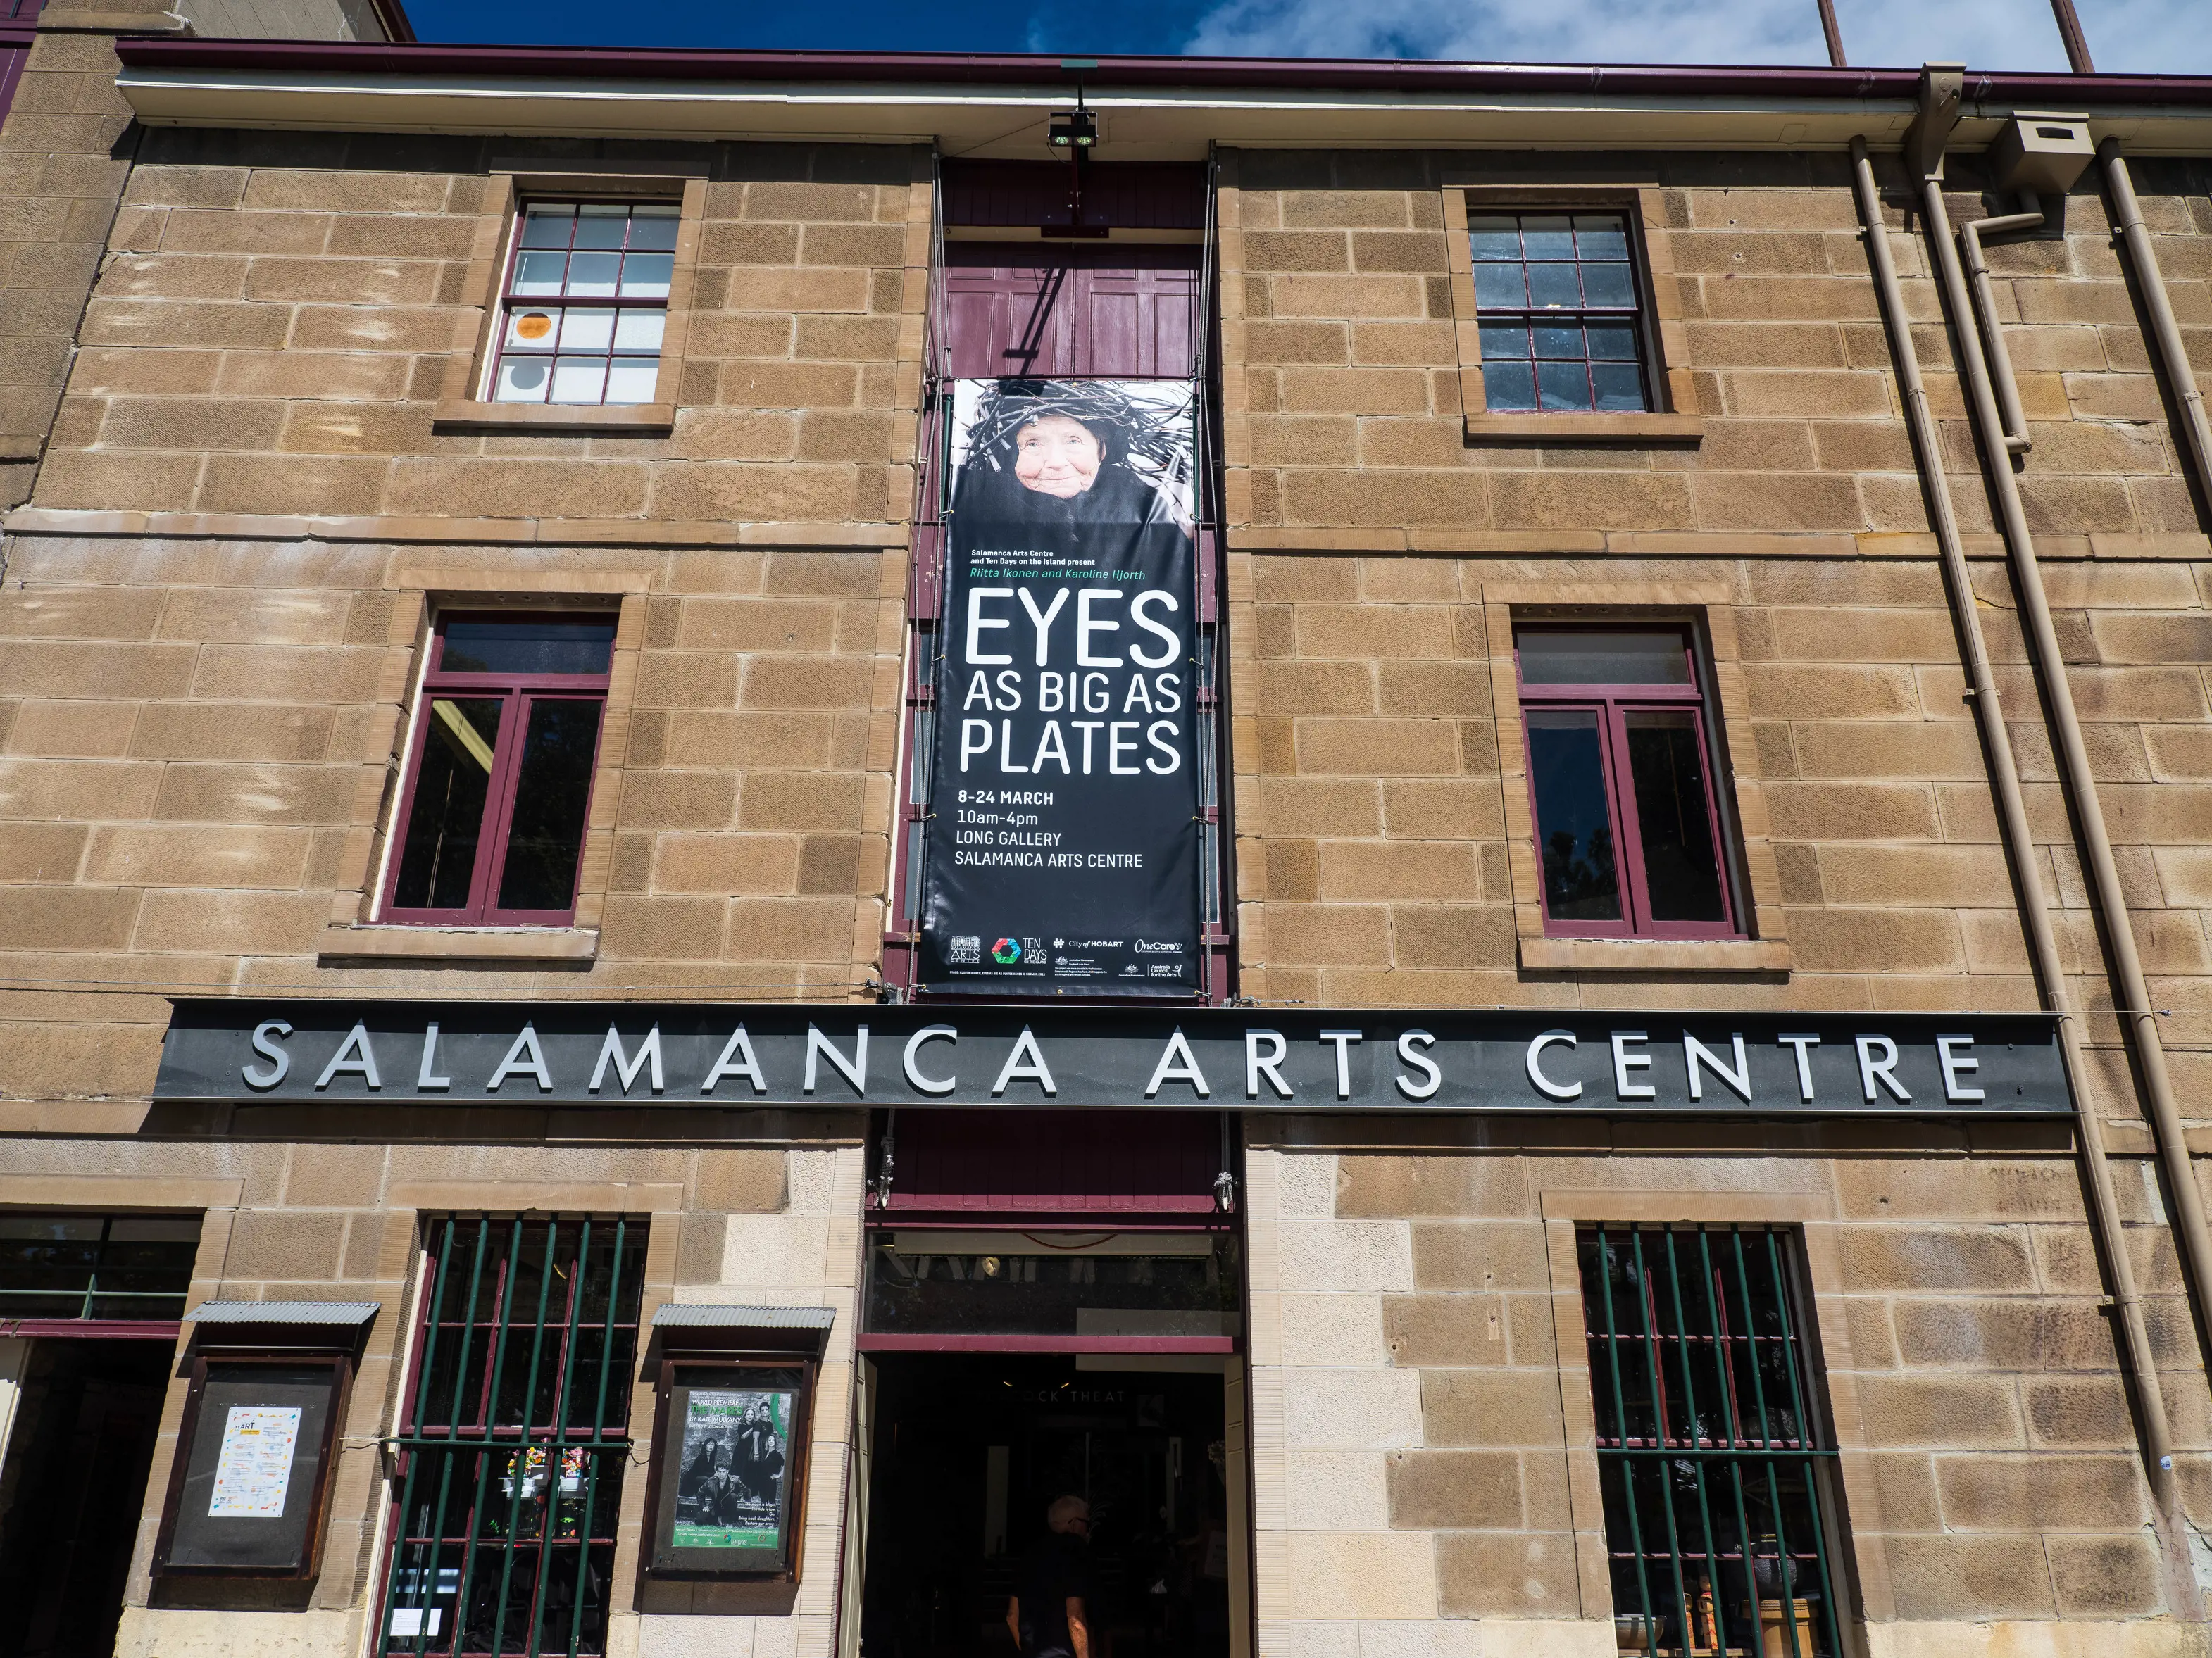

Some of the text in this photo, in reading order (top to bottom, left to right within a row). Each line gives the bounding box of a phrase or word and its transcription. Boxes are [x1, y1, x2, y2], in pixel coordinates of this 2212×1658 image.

[1000, 558, 1017, 566] Days
[970, 568, 1145, 580] Riitta Ikonen and Karoline Hjorth
[966, 587, 1181, 668] EYES
[963, 670, 1181, 714] AS BIG AS
[961, 718, 1181, 774] PLATES
[958, 790, 1054, 805] 8-24 MARCH
[957, 810, 1038, 827] 10am-4pm
[956, 830, 1061, 846] LONG GALLERY
[955, 851, 1142, 868] SALAMANCA ARTS CENTRE
[1023, 938, 1041, 949] TEN
[1135, 939, 1175, 953] OneCare
[951, 950, 980, 959] ARTS
[1024, 949, 1046, 960] DAYS
[242, 1018, 1986, 1105] SALAMANCA ARTS CENTRE
[692, 1405, 743, 1415] THE MARES
